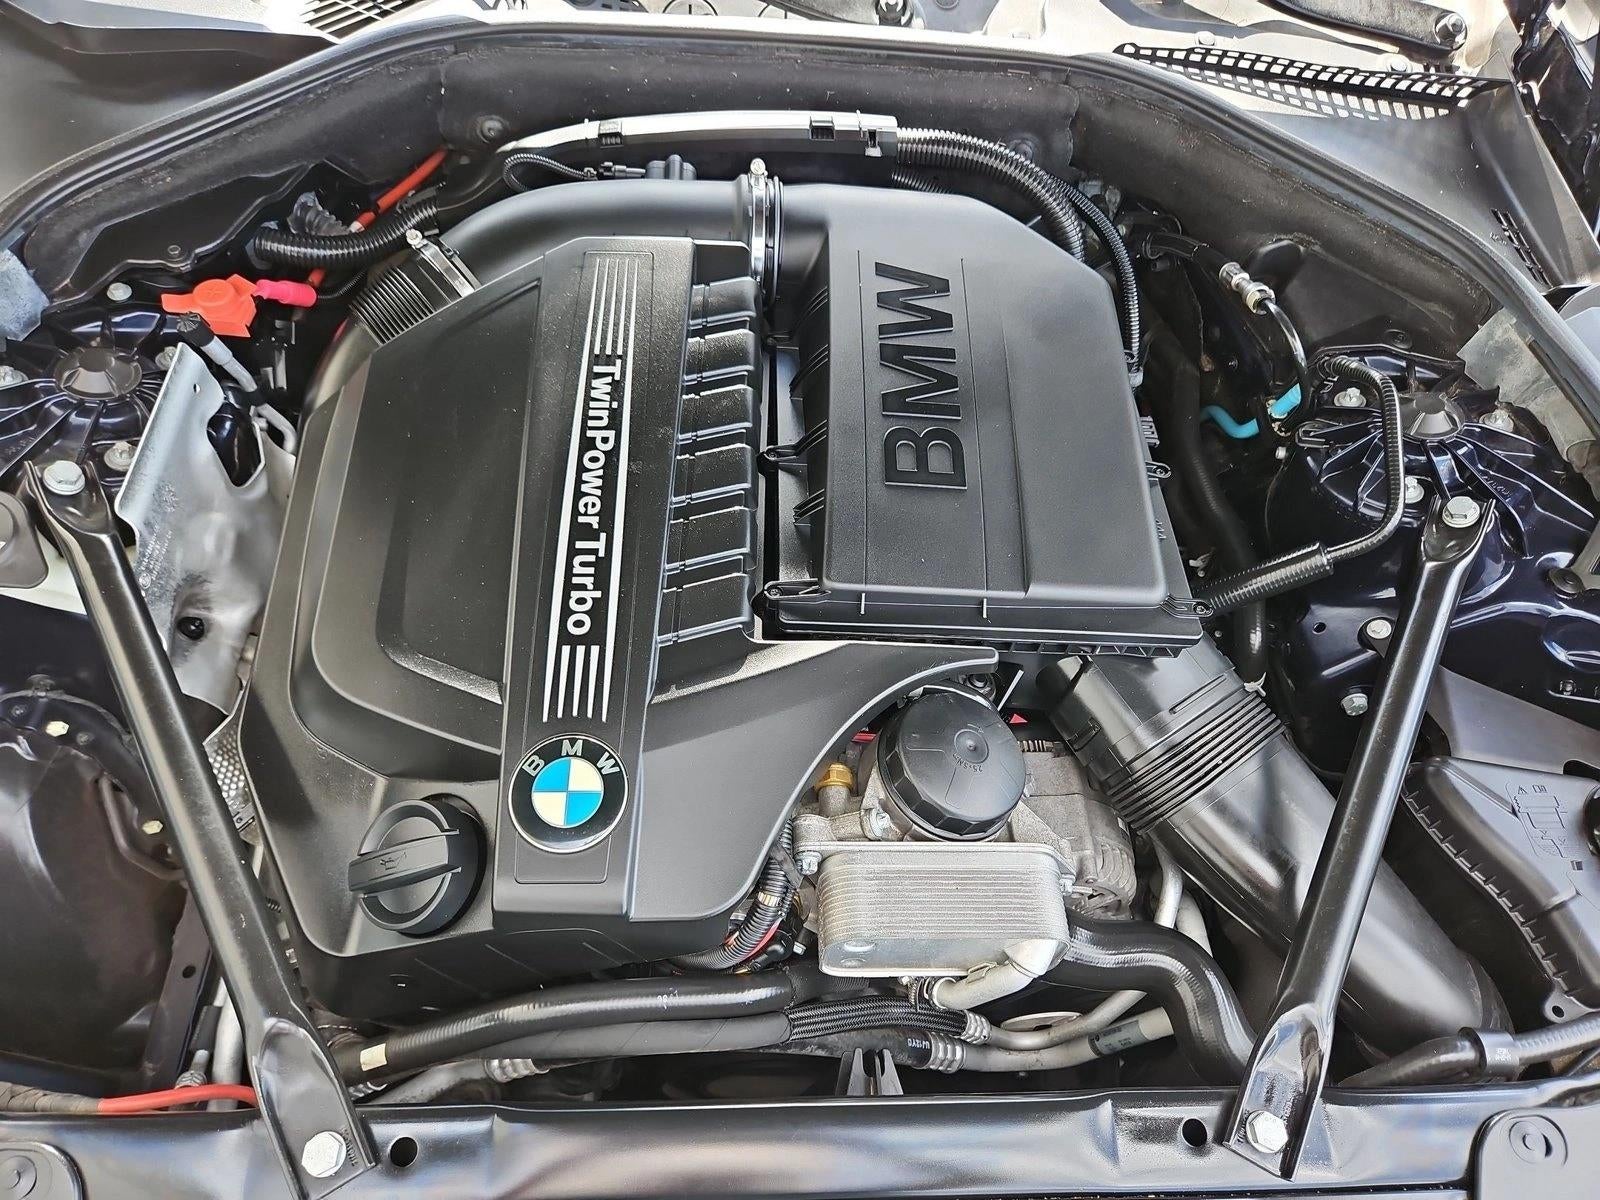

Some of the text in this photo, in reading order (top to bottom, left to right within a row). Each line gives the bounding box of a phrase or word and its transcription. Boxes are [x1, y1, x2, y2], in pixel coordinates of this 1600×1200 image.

[874, 261, 968, 490] BMW
[566, 358, 622, 636] TwinPower Turbo
[521, 739, 621, 777] BMW
